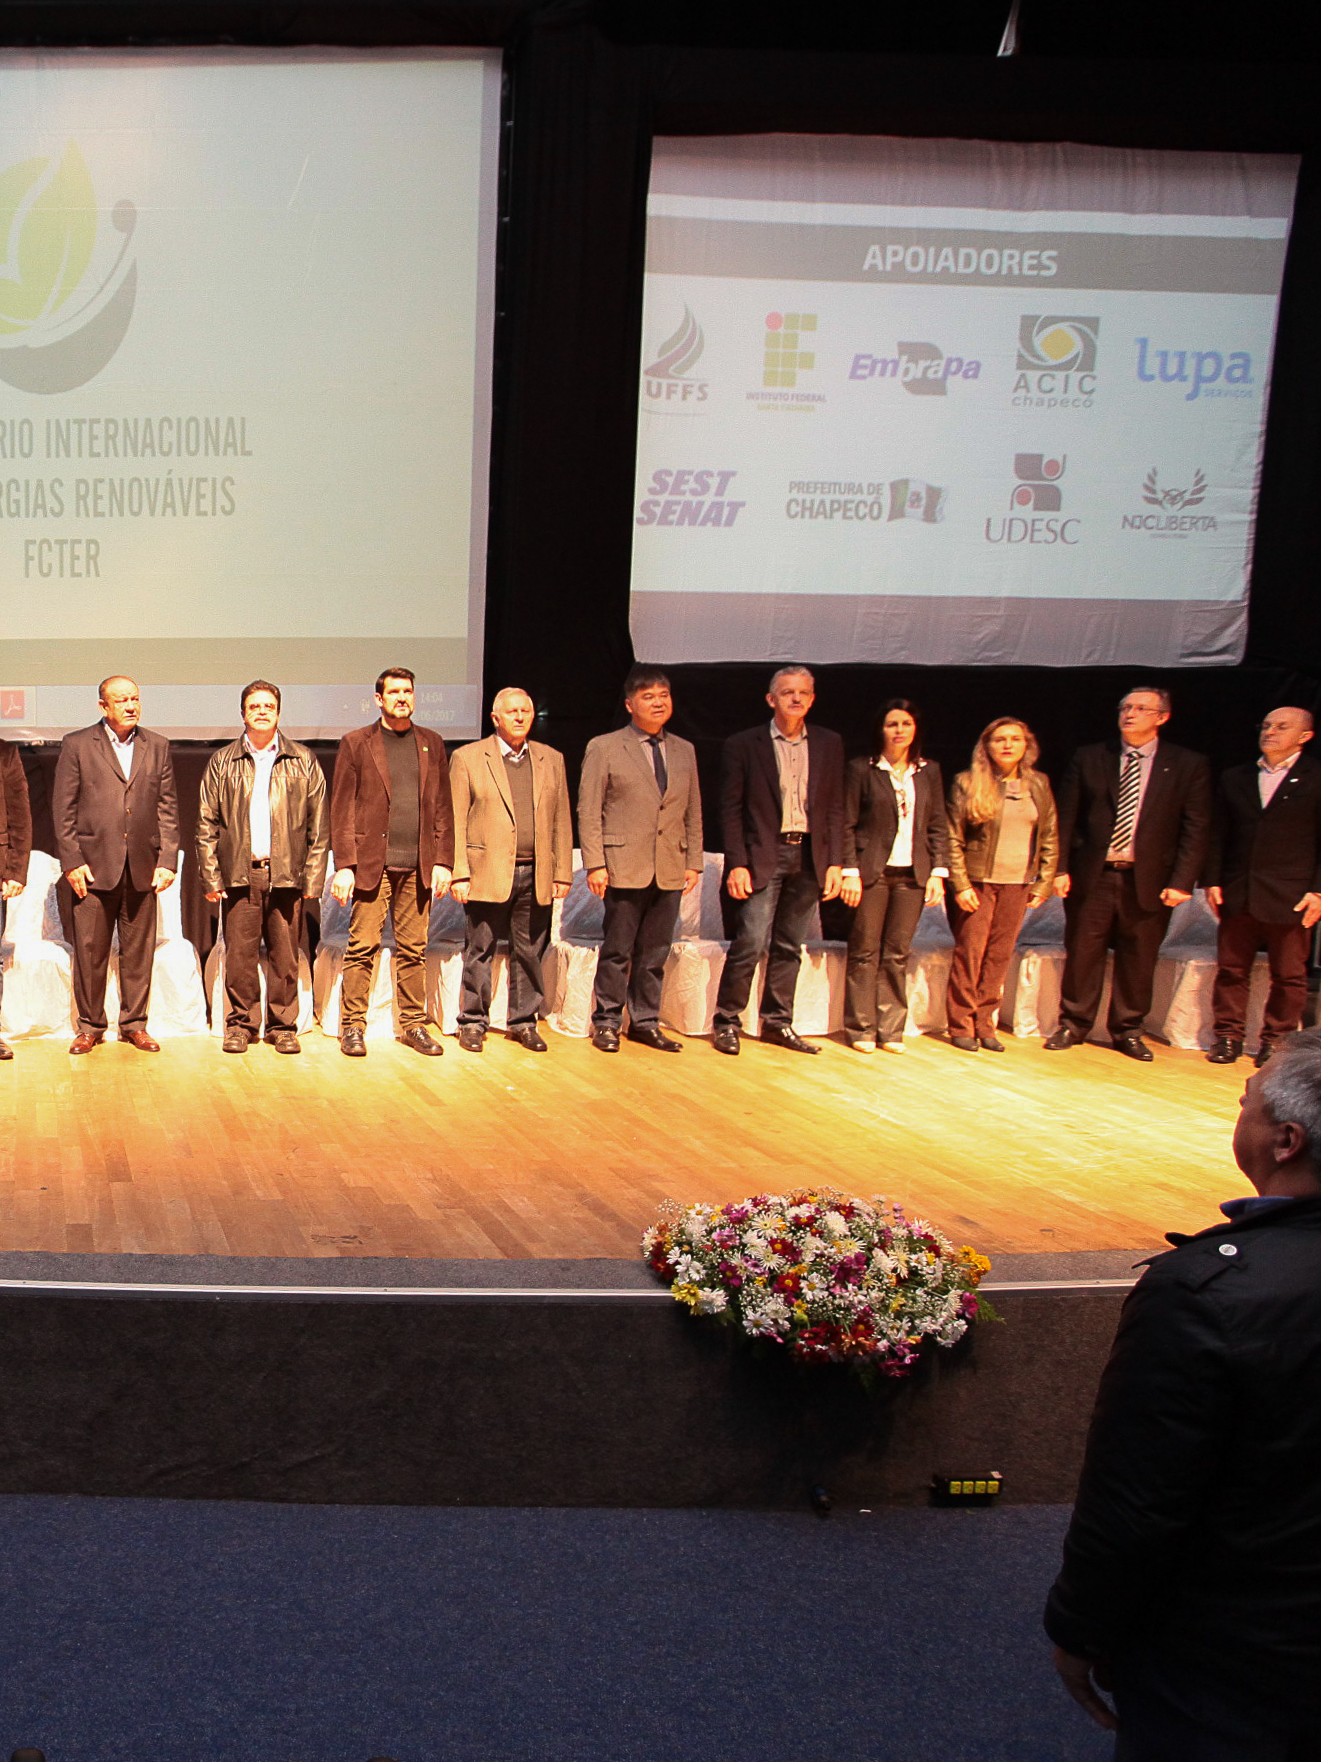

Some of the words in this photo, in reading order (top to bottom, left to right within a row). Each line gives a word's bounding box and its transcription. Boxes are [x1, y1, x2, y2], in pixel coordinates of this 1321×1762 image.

[863, 245, 1058, 277] APOIADORES
[849, 354, 981, 382] Embrapa
[1134, 337, 1254, 401] lupa
[646, 381, 709, 401] UFFS
[1013, 373, 1096, 395] ACIC
[45, 416, 253, 458] INTERNACIONAL
[76, 469, 237, 518] RENOVÁVEIS
[647, 469, 738, 498] SEST
[788, 480, 864, 496] PREFEITURA
[867, 482, 884, 496] DE
[636, 499, 746, 527] SENAT
[985, 517, 1082, 544] UDESC
[24, 538, 101, 578] FCTER
